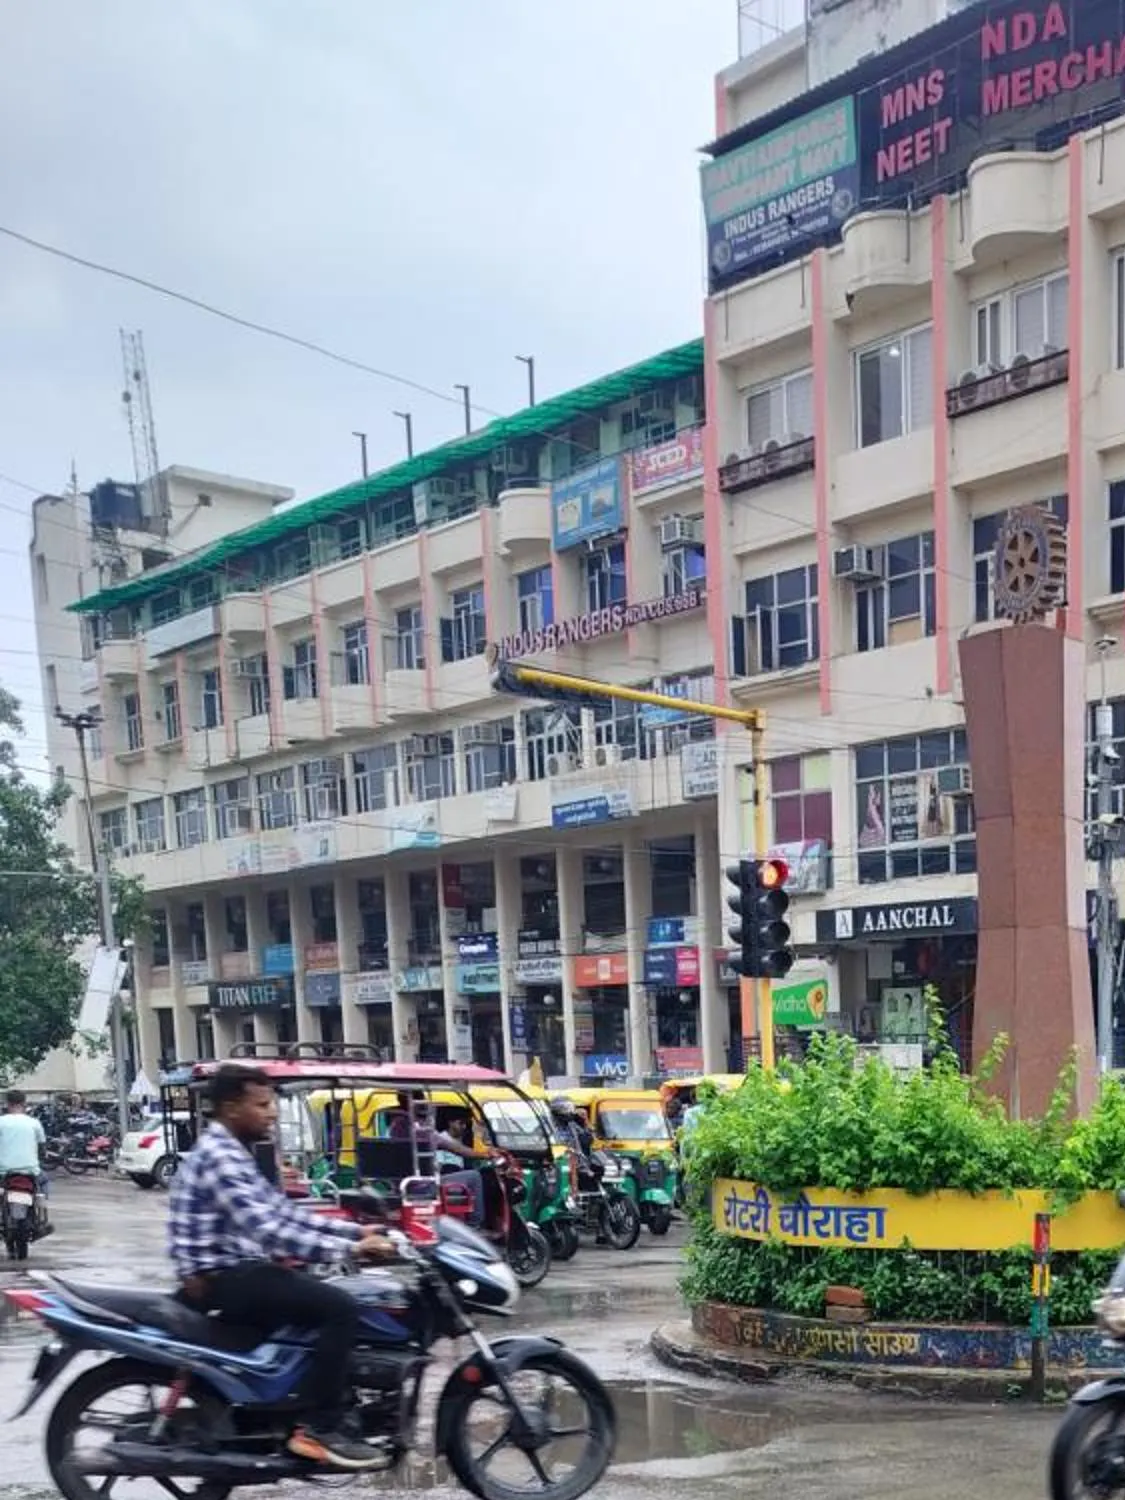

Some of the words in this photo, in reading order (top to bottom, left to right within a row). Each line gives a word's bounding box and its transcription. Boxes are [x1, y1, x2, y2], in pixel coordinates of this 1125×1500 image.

[980, 2, 1067, 60] NDA
[881, 68, 945, 129] MNS
[876, 116, 953, 183] NEET
[723, 208, 766, 239] INDUS
[767, 175, 836, 220] RANGERS
[501, 628, 545, 660] INDUS
[544, 604, 623, 653] RANGERS
[862, 905, 955, 932] AANCHAL
[217, 985, 251, 1006] TITAN
[595, 1058, 628, 1075] vivo
[723, 1183, 772, 1233] रोटरी
